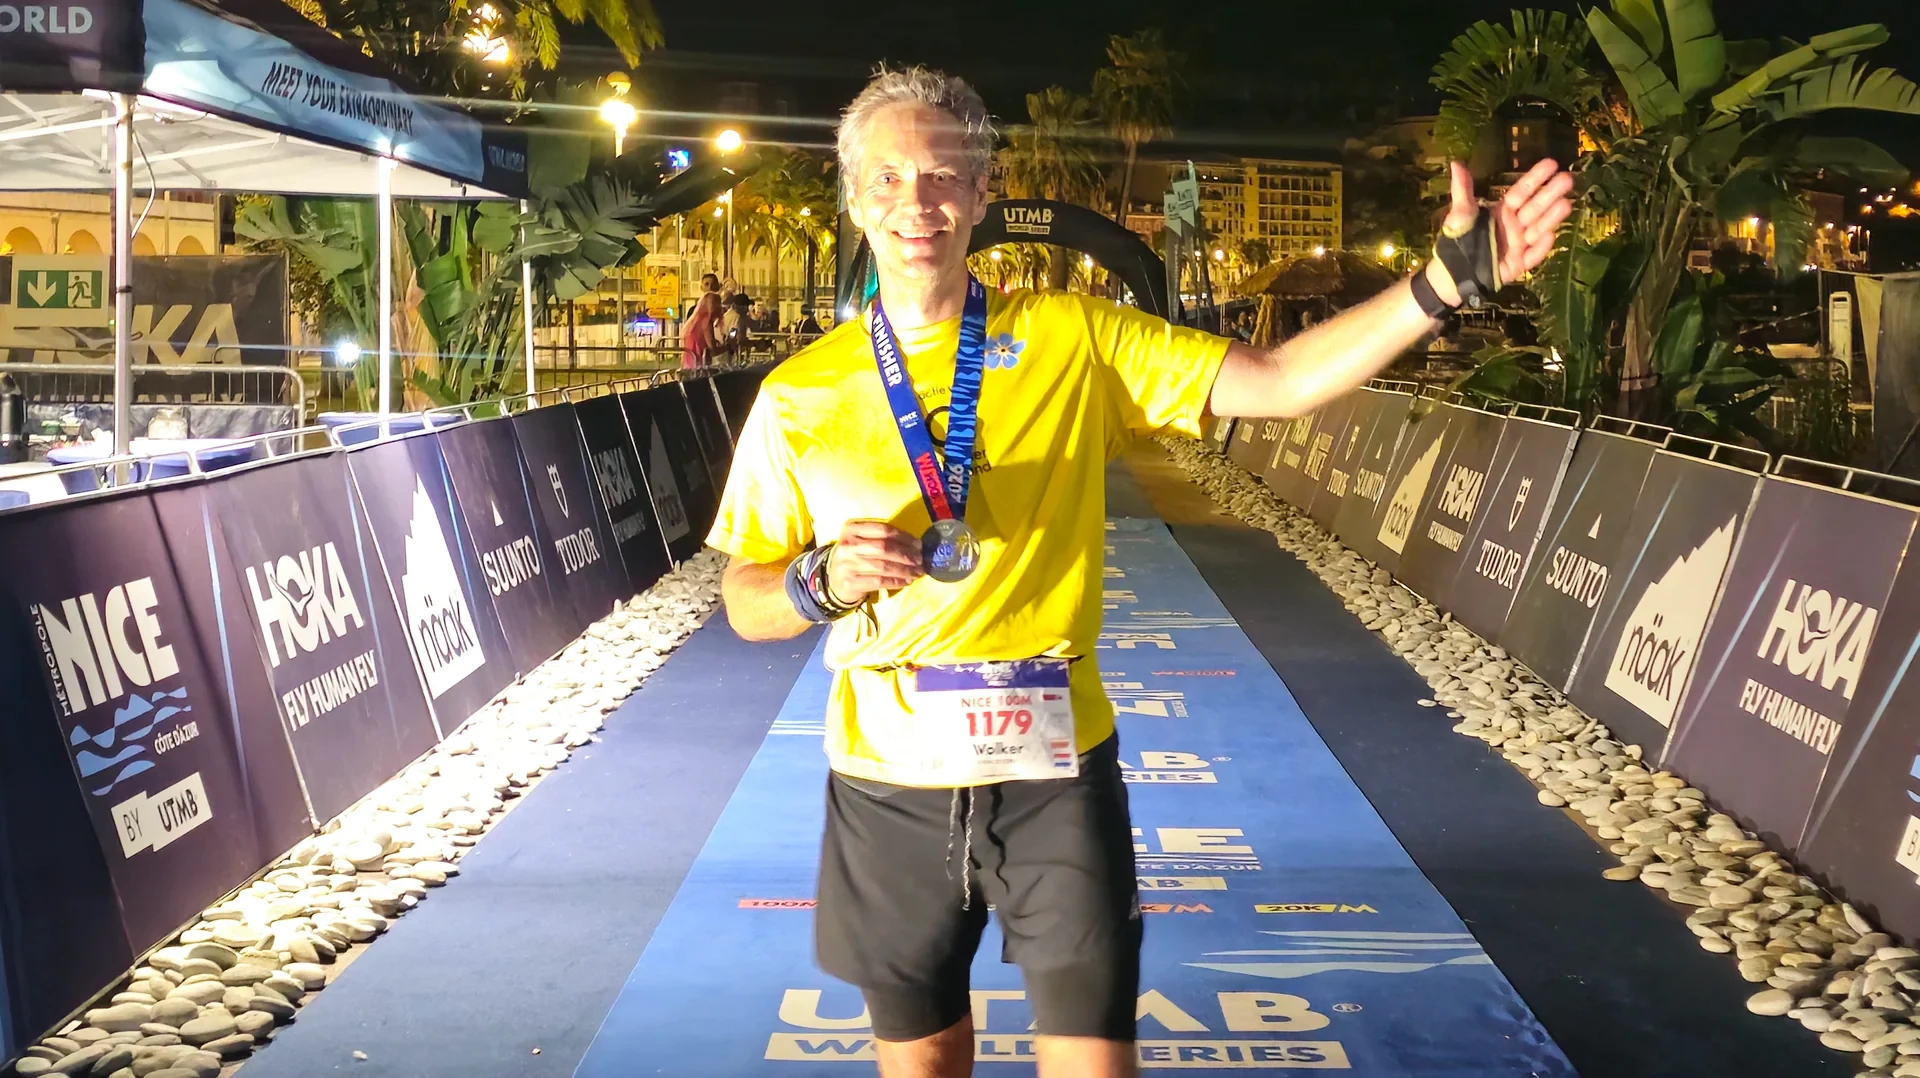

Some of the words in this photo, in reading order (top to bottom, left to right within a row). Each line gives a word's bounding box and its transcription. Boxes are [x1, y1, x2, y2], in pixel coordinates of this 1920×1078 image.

[0, 5, 93, 34] ORLD
[261, 61, 303, 100] MEET
[301, 72, 336, 113] YOUR
[339, 85, 414, 136] EXTRAORDINARY
[1003, 207, 1052, 223] UTMB
[873, 313, 903, 388] FINISHER
[947, 462, 965, 503] 2026
[1438, 464, 1484, 522] HOKA
[483, 535, 541, 597] SUUNTO
[555, 527, 600, 575] TUDOR
[1475, 539, 1522, 589] TUDOR
[1546, 546, 1608, 608] SUUNTO
[245, 541, 364, 668] HOKA
[417, 594, 475, 673] näak
[38, 576, 180, 714] NICE
[1619, 613, 1686, 701] näak
[1757, 578, 1878, 700] HOKA
[282, 683, 310, 732] FLY
[305, 659, 362, 718] HUMAN
[353, 649, 379, 691] FLY
[961, 696, 992, 709] NICE
[1739, 678, 1769, 715] FLY
[1760, 688, 1819, 745] HUMAN
[1810, 714, 1842, 755] FLY
[965, 709, 1033, 736] 1179
[123, 807, 143, 842] BY
[157, 788, 199, 833] UTMB
[1139, 1045, 1327, 1063] ERIES
